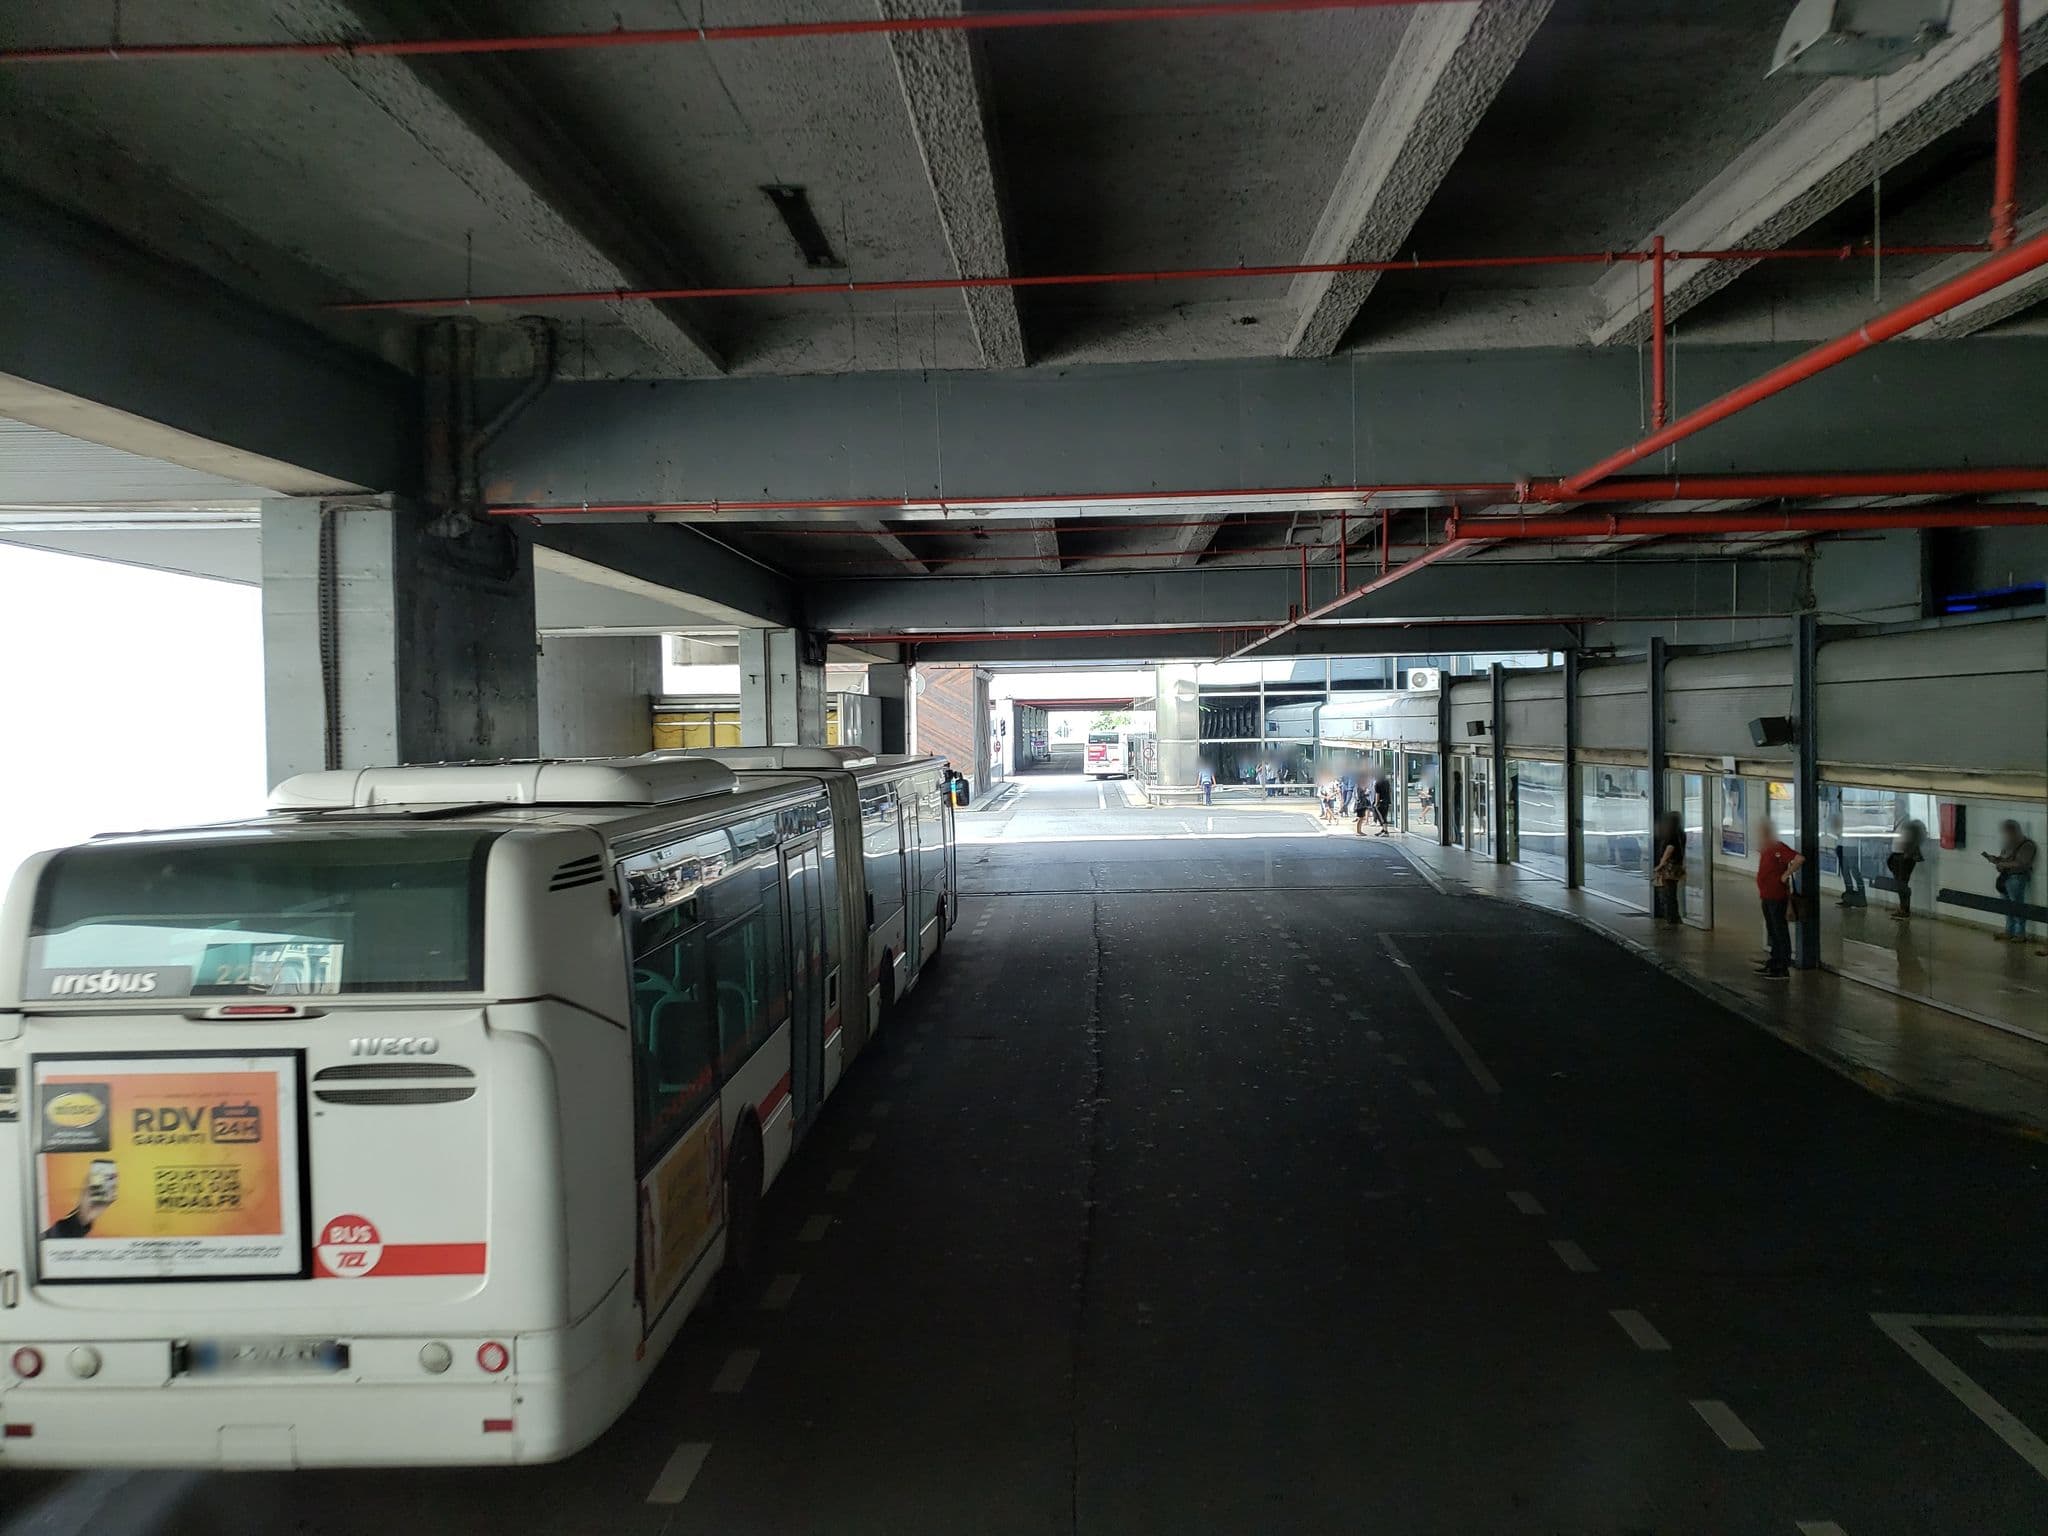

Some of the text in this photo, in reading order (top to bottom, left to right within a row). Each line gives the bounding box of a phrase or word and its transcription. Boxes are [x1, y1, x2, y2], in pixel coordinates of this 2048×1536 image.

[350, 1036, 439, 1056] IVECO
[133, 1106, 207, 1132] RDV
[214, 1120, 259, 1137] 24H
[155, 1168, 241, 1181] POUR TOUT
[155, 1181, 241, 1194] DEVIS SUR
[329, 1225, 372, 1243] BUS
